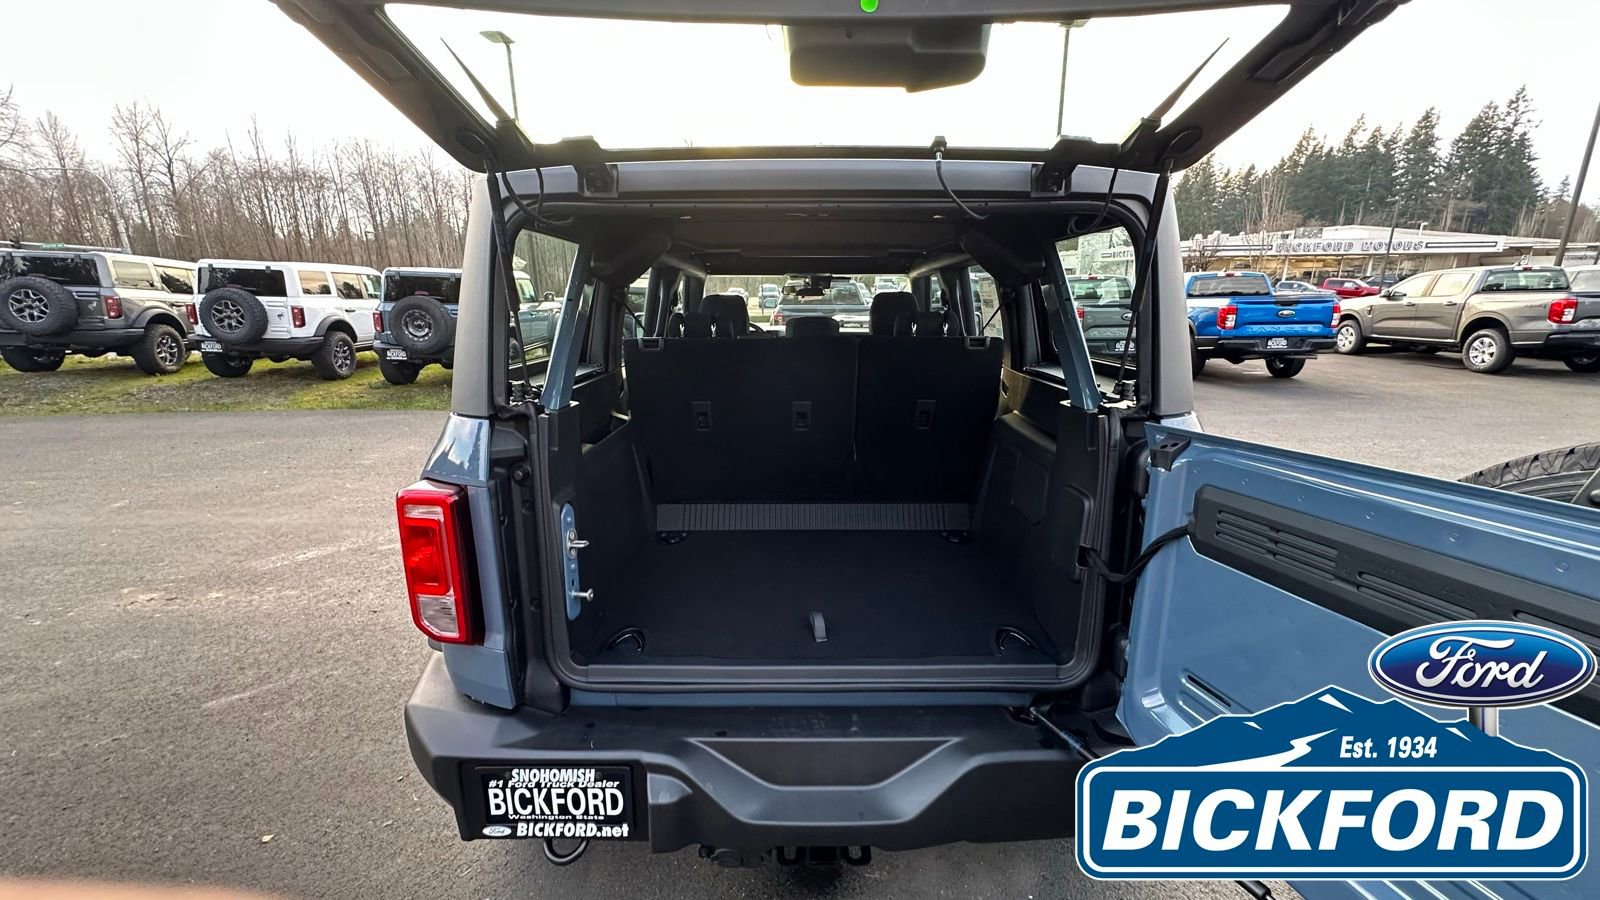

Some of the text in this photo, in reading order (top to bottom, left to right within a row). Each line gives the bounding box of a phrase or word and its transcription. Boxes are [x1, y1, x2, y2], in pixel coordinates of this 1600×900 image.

[1276, 242, 1354, 252] BICKFORD
[511, 768, 596, 783] SNOHOMISH
[488, 780, 620, 788] #1 Ford Truck Dealer
[487, 788, 624, 816] BICKFORD
[516, 822, 630, 837] BICKFORD.net
